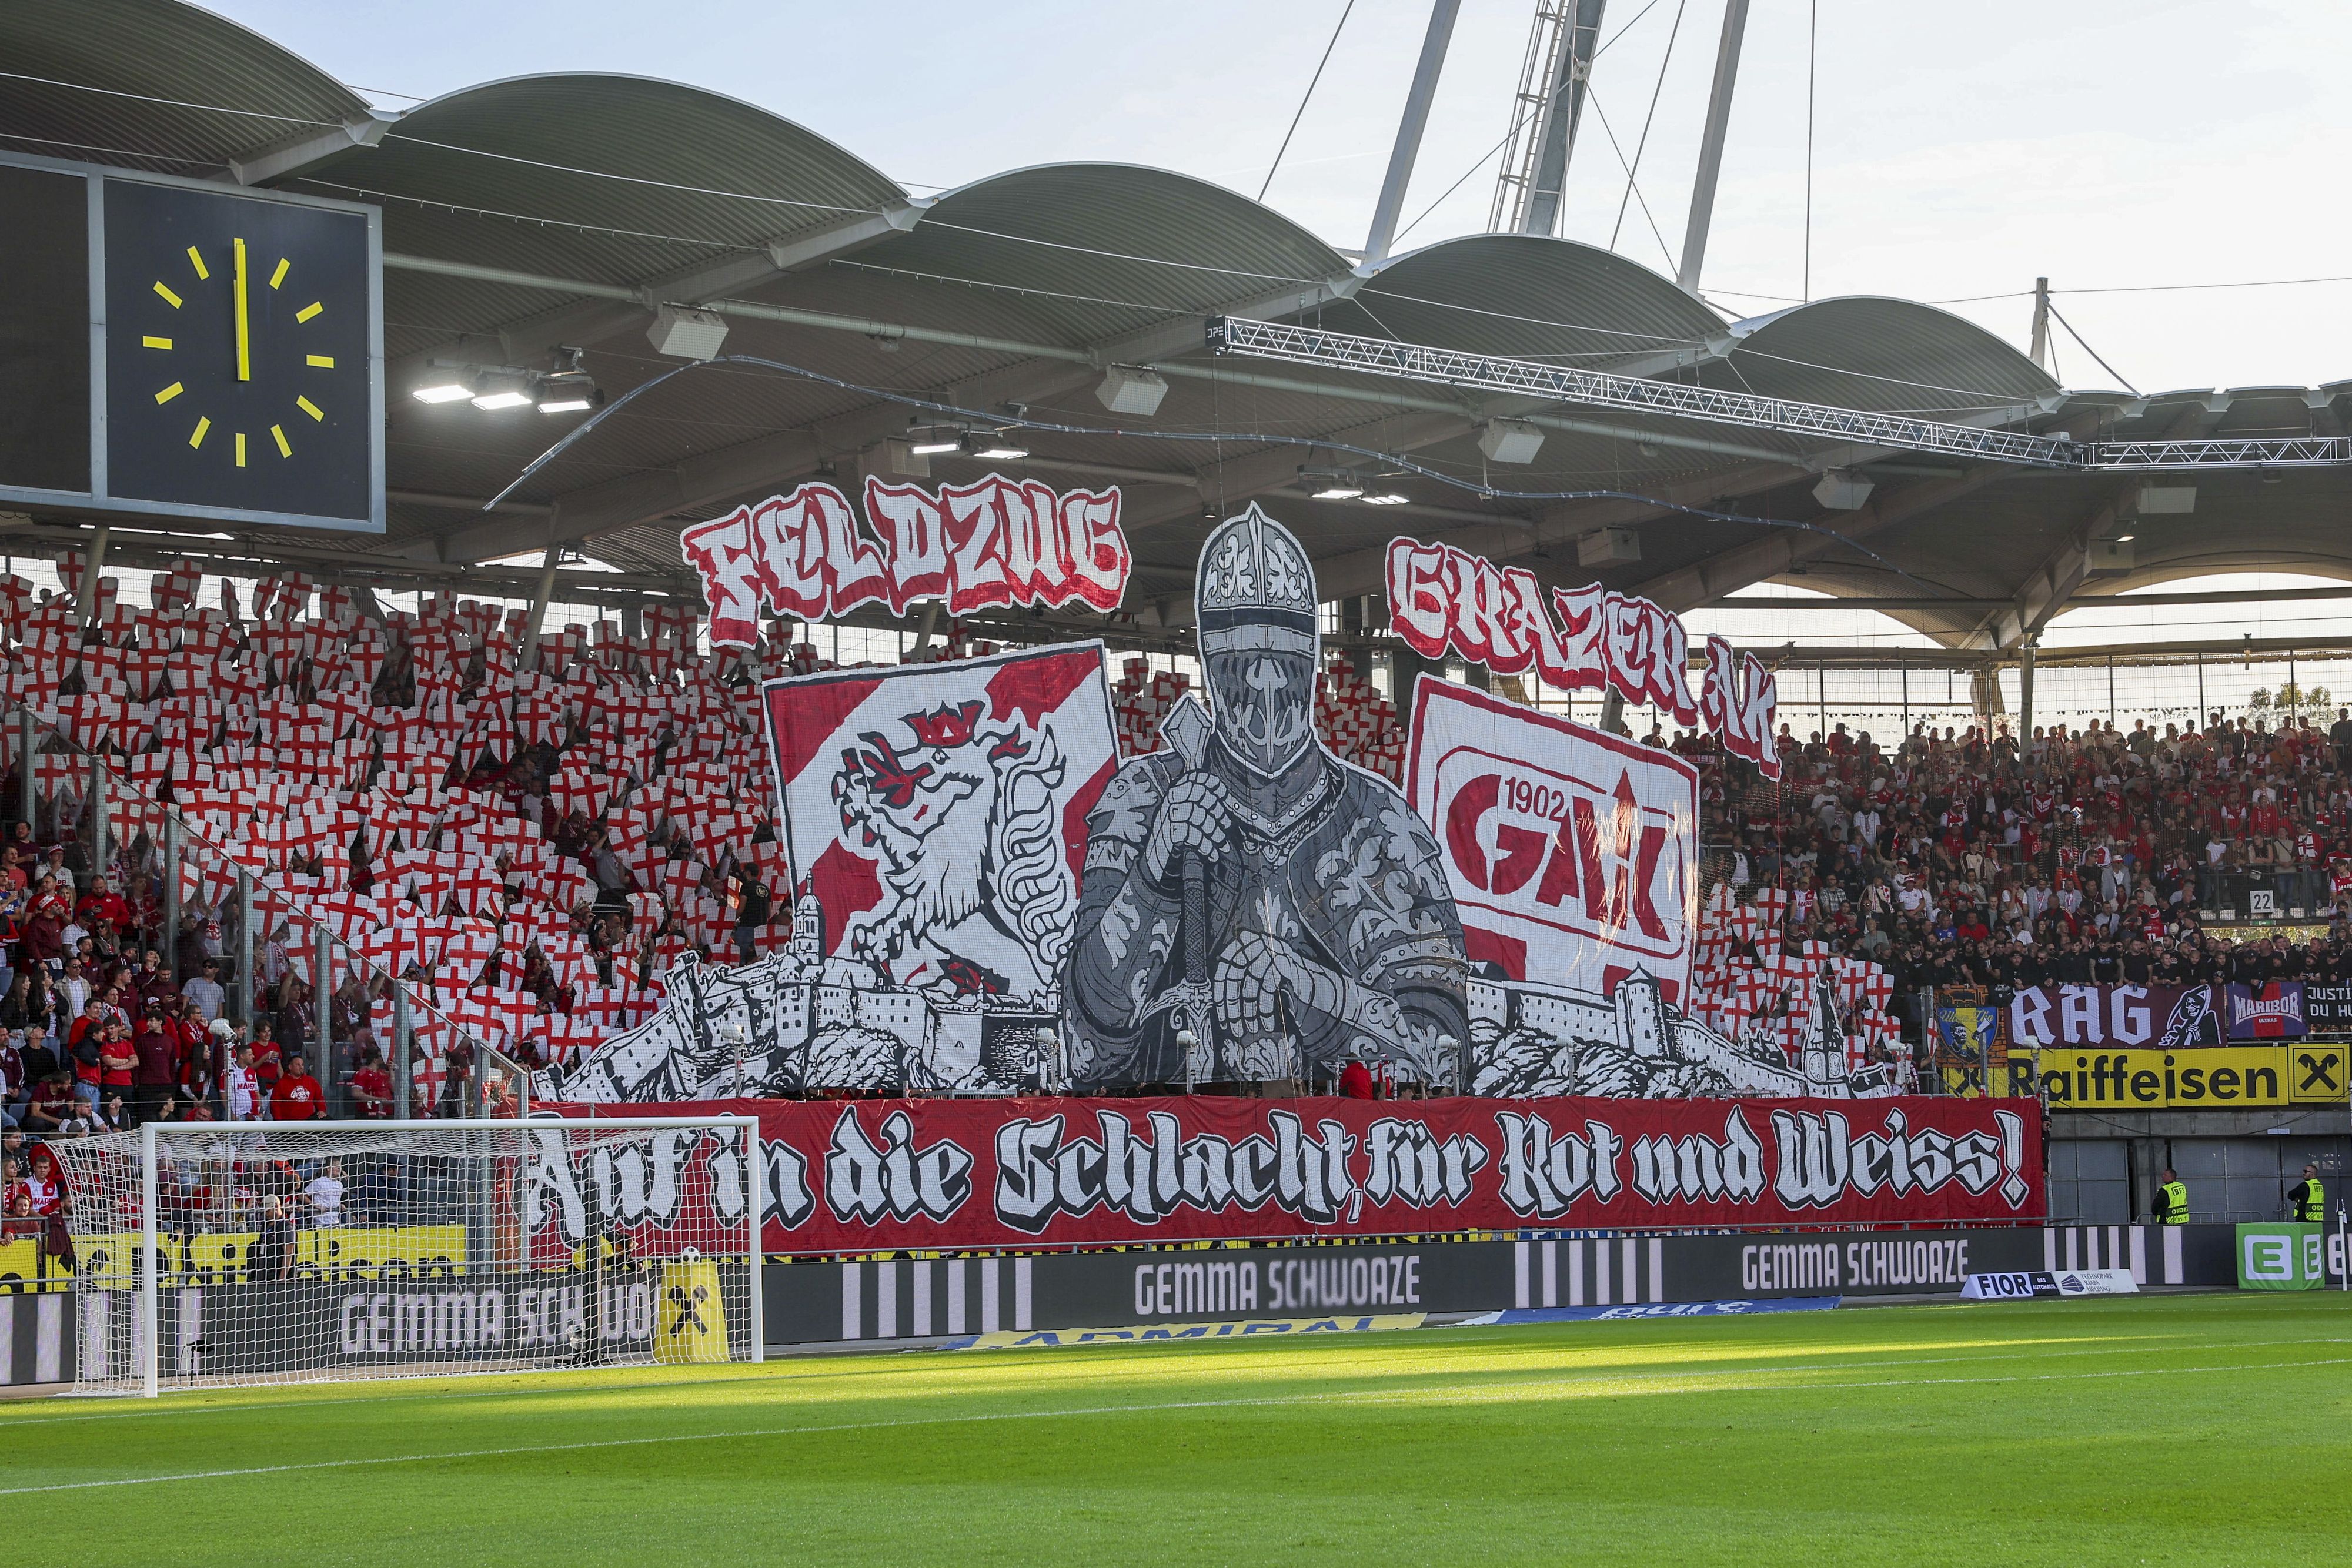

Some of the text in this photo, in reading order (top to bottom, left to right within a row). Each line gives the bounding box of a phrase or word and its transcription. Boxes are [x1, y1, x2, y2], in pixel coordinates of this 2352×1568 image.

[681, 473, 1131, 648] FELDZUG
[1385, 536, 1782, 781] GRAZER AK
[1505, 776, 1566, 822] 1902
[1446, 766, 1670, 942] GAK
[2254, 894, 2271, 910] 22
[2010, 984, 2151, 1046] RAG
[2234, 992, 2300, 1021] MARIBOR
[2310, 1004, 2329, 1017] DU
[2008, 1055, 2277, 1102] Raiffeisen
[512, 1104, 2030, 1251] Auf in die Schlacht, für Rot und Weiss!
[1742, 1239, 1969, 1290] GEMMA SCHWOAZE
[2253, 1242, 2284, 1273] E
[1135, 1255, 1420, 1315] GEMMA SCHWOAZE
[1977, 1274, 2031, 1296] FIOR
[340, 1289, 503, 1353] GEMMA
